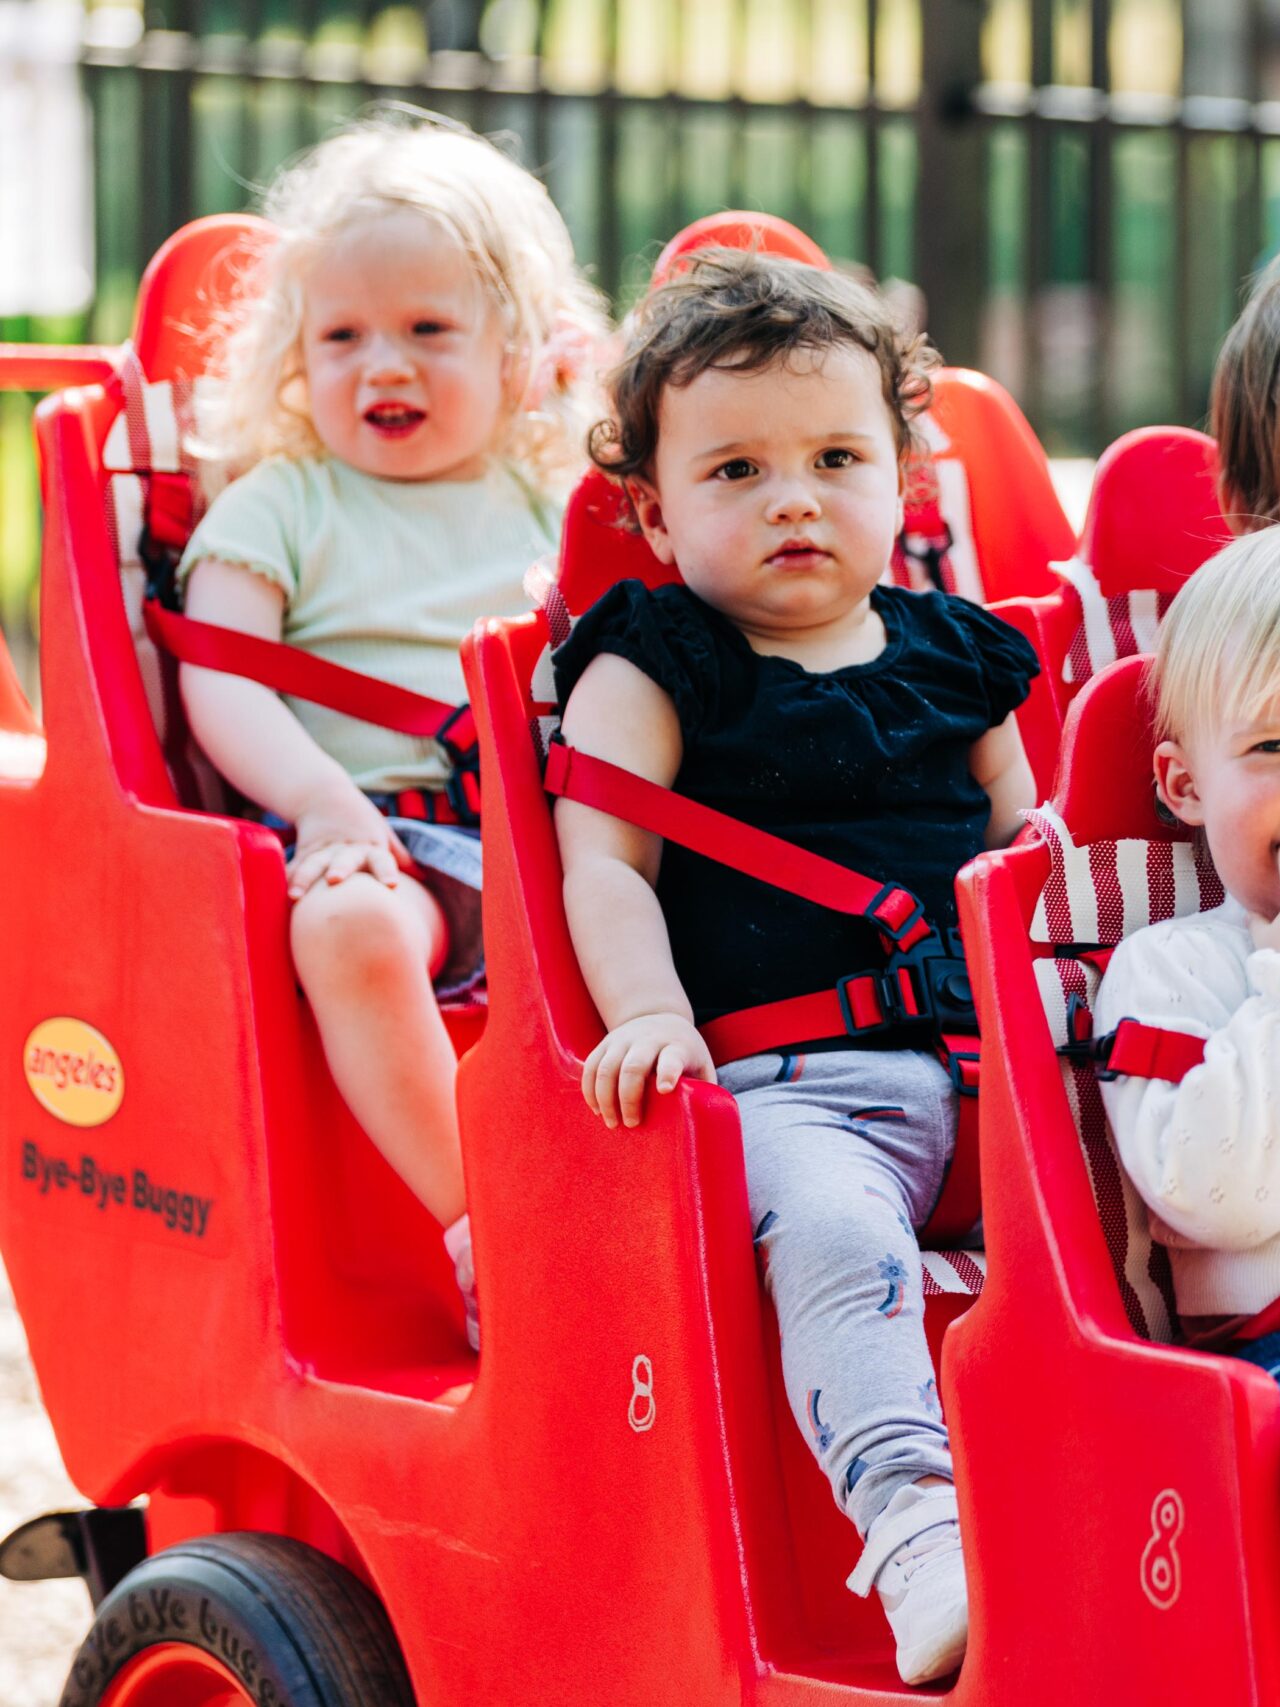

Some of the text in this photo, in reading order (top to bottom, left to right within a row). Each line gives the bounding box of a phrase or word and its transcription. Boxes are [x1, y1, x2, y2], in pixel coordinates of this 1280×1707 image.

[27, 1047, 117, 1093] angeles
[21, 1140, 212, 1237] Bye-Bye Buggy
[628, 1354, 656, 1433] 8
[128, 1588, 187, 1633] bye
[199, 1598, 287, 1707] bugg
